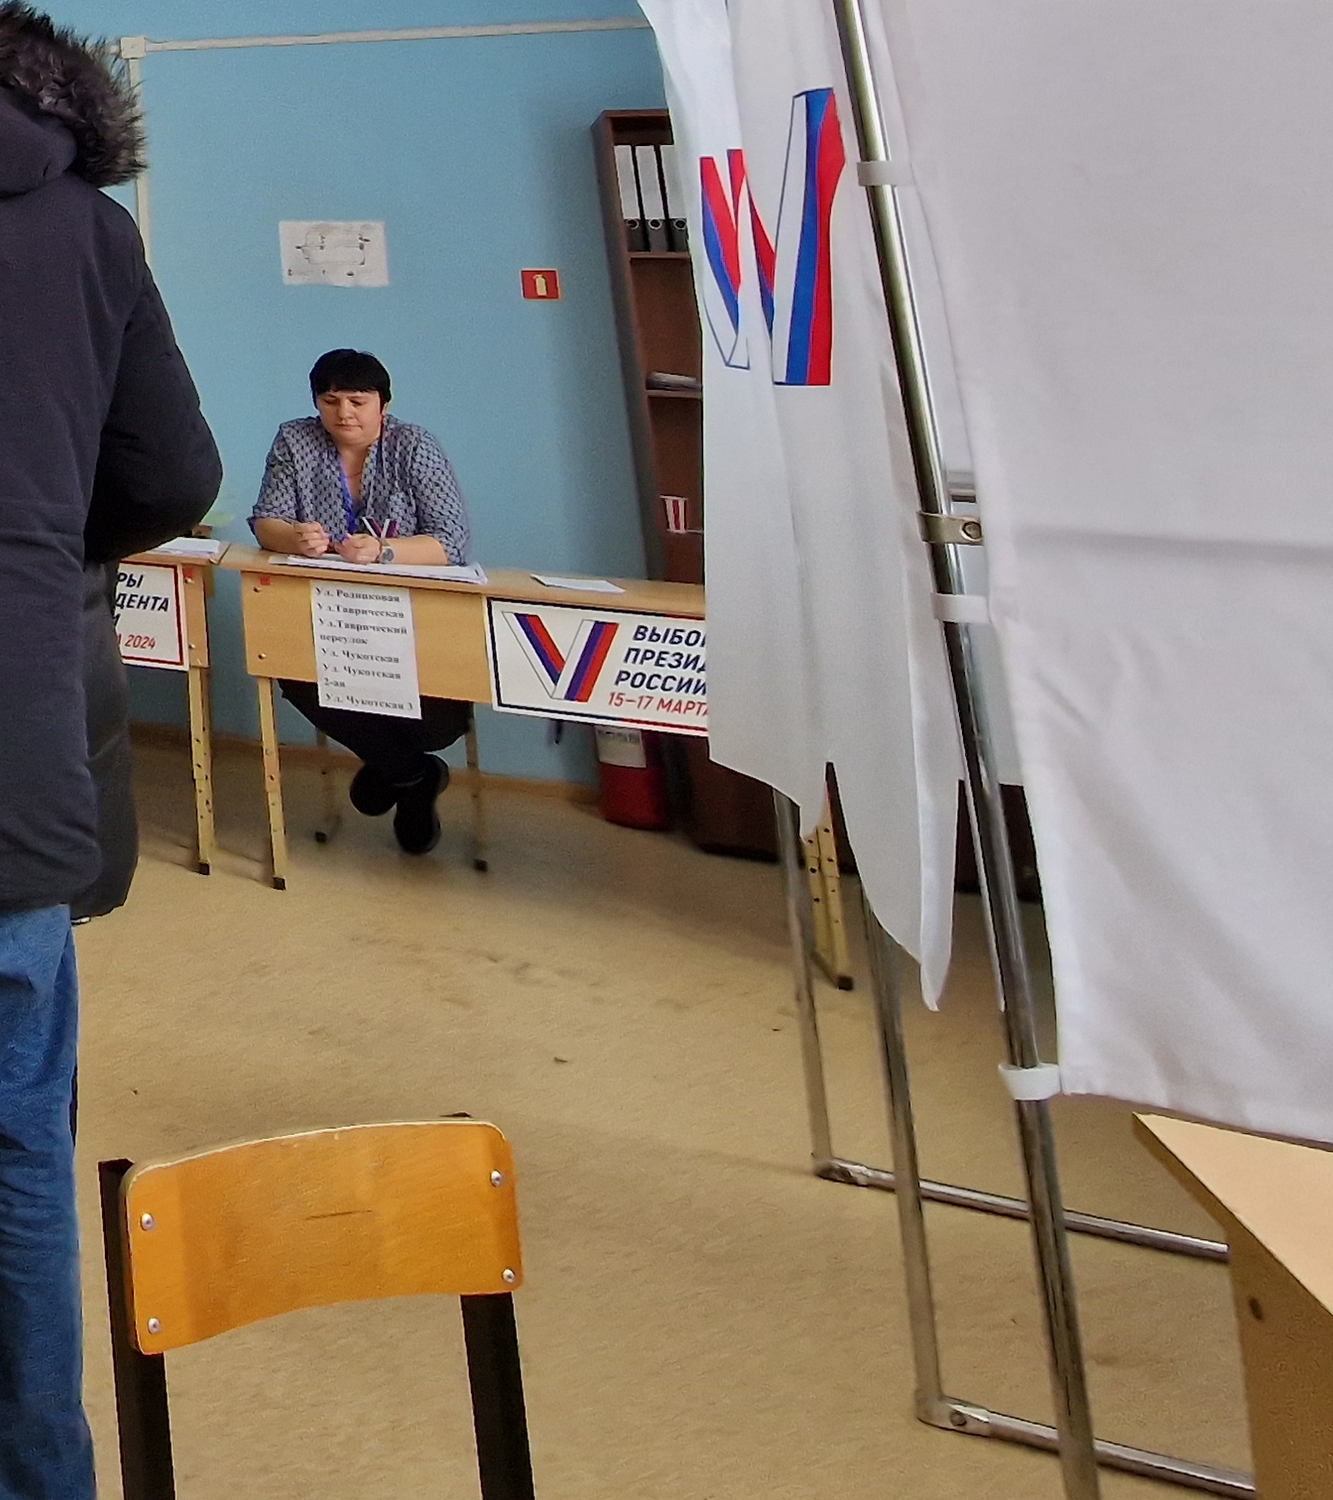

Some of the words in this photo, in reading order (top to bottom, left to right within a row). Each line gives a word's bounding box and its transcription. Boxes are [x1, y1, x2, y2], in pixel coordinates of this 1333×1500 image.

[336, 588, 400, 603] Родниковая
[124, 634, 156, 649] 2024
[319, 633, 368, 645] переулок
[342, 649, 400, 664] Чукотская
[343, 665, 401, 680] Чукотская
[614, 669, 707, 697] РОССИИ
[346, 694, 404, 711] Чукотская
